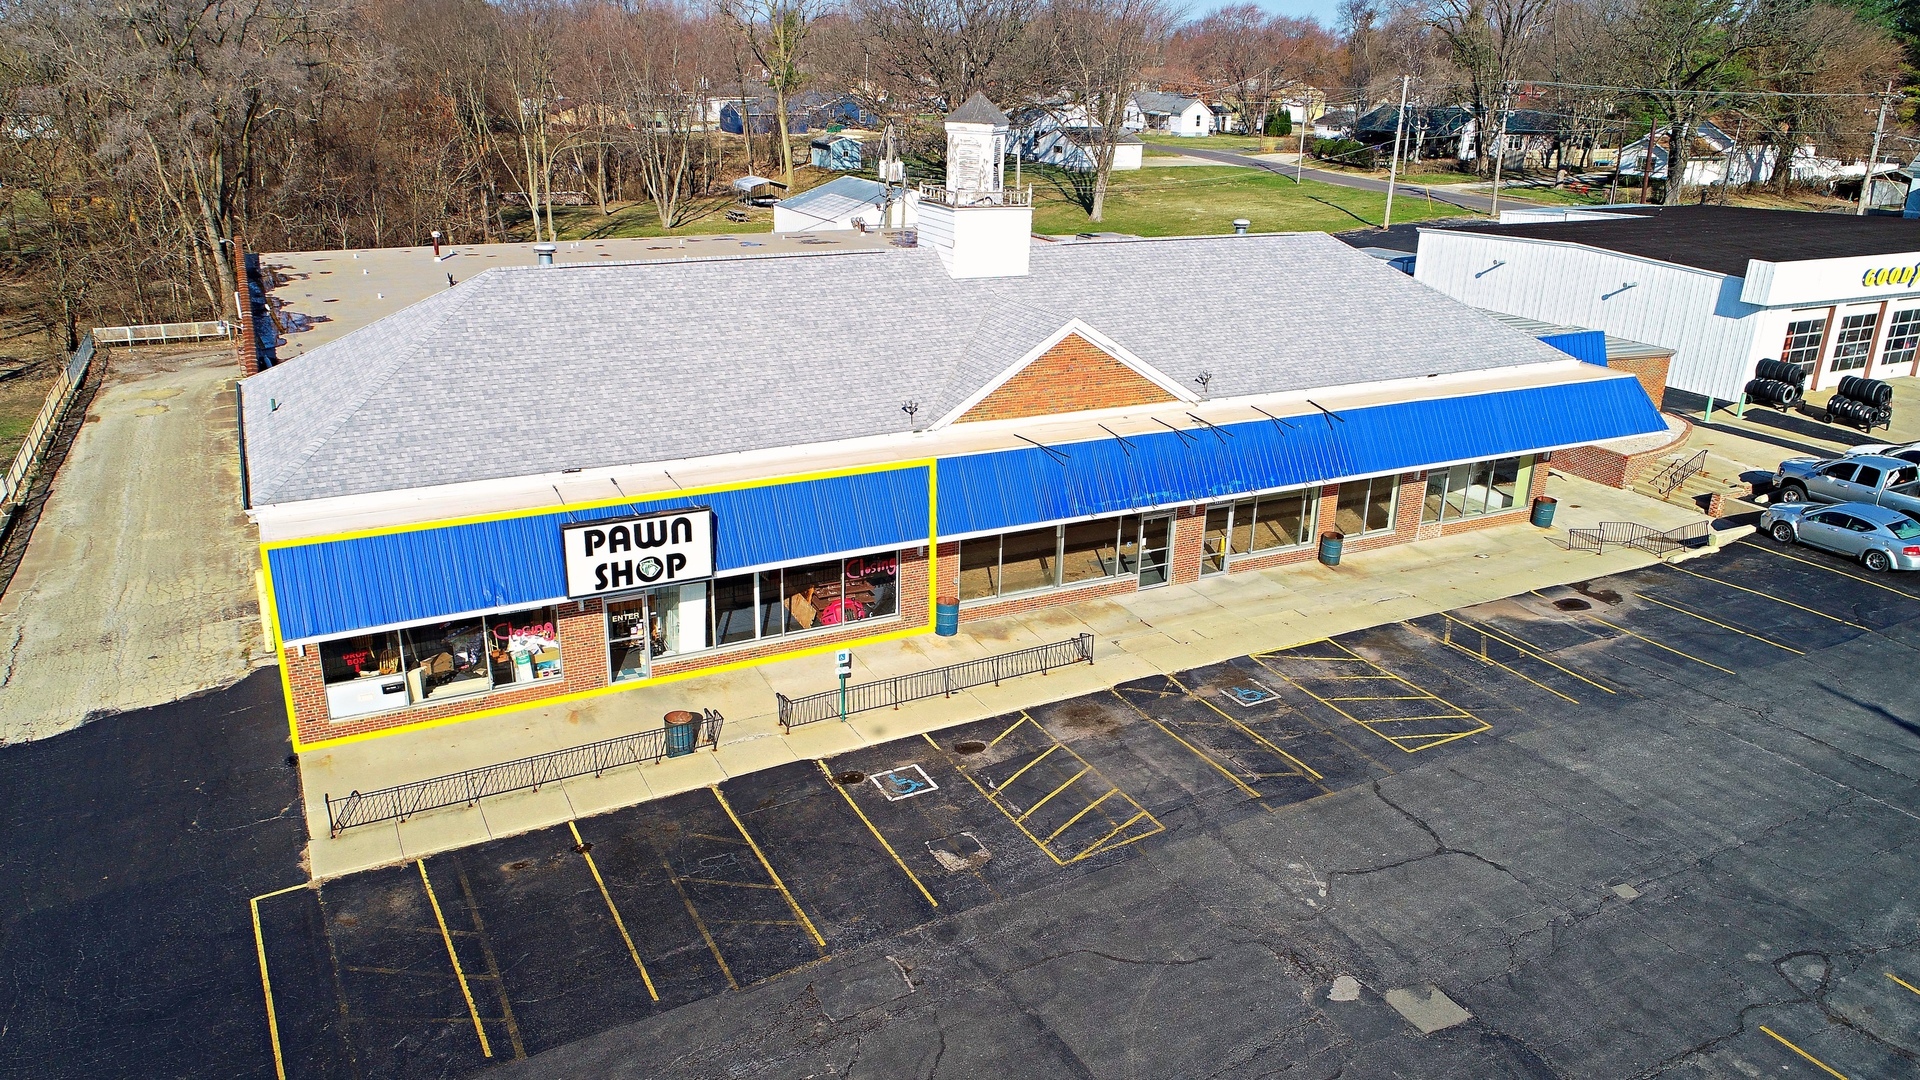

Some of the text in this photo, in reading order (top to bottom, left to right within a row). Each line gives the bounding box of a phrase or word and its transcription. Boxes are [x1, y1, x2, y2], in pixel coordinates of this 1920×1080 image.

[584, 517, 693, 557] PAWN
[595, 552, 687, 591] SHOP
[846, 557, 896, 579] Closing
[612, 612, 640, 623] ENTER
[493, 621, 554, 642] Closing
[342, 651, 368, 660] DROP
[347, 657, 366, 666] BOX
